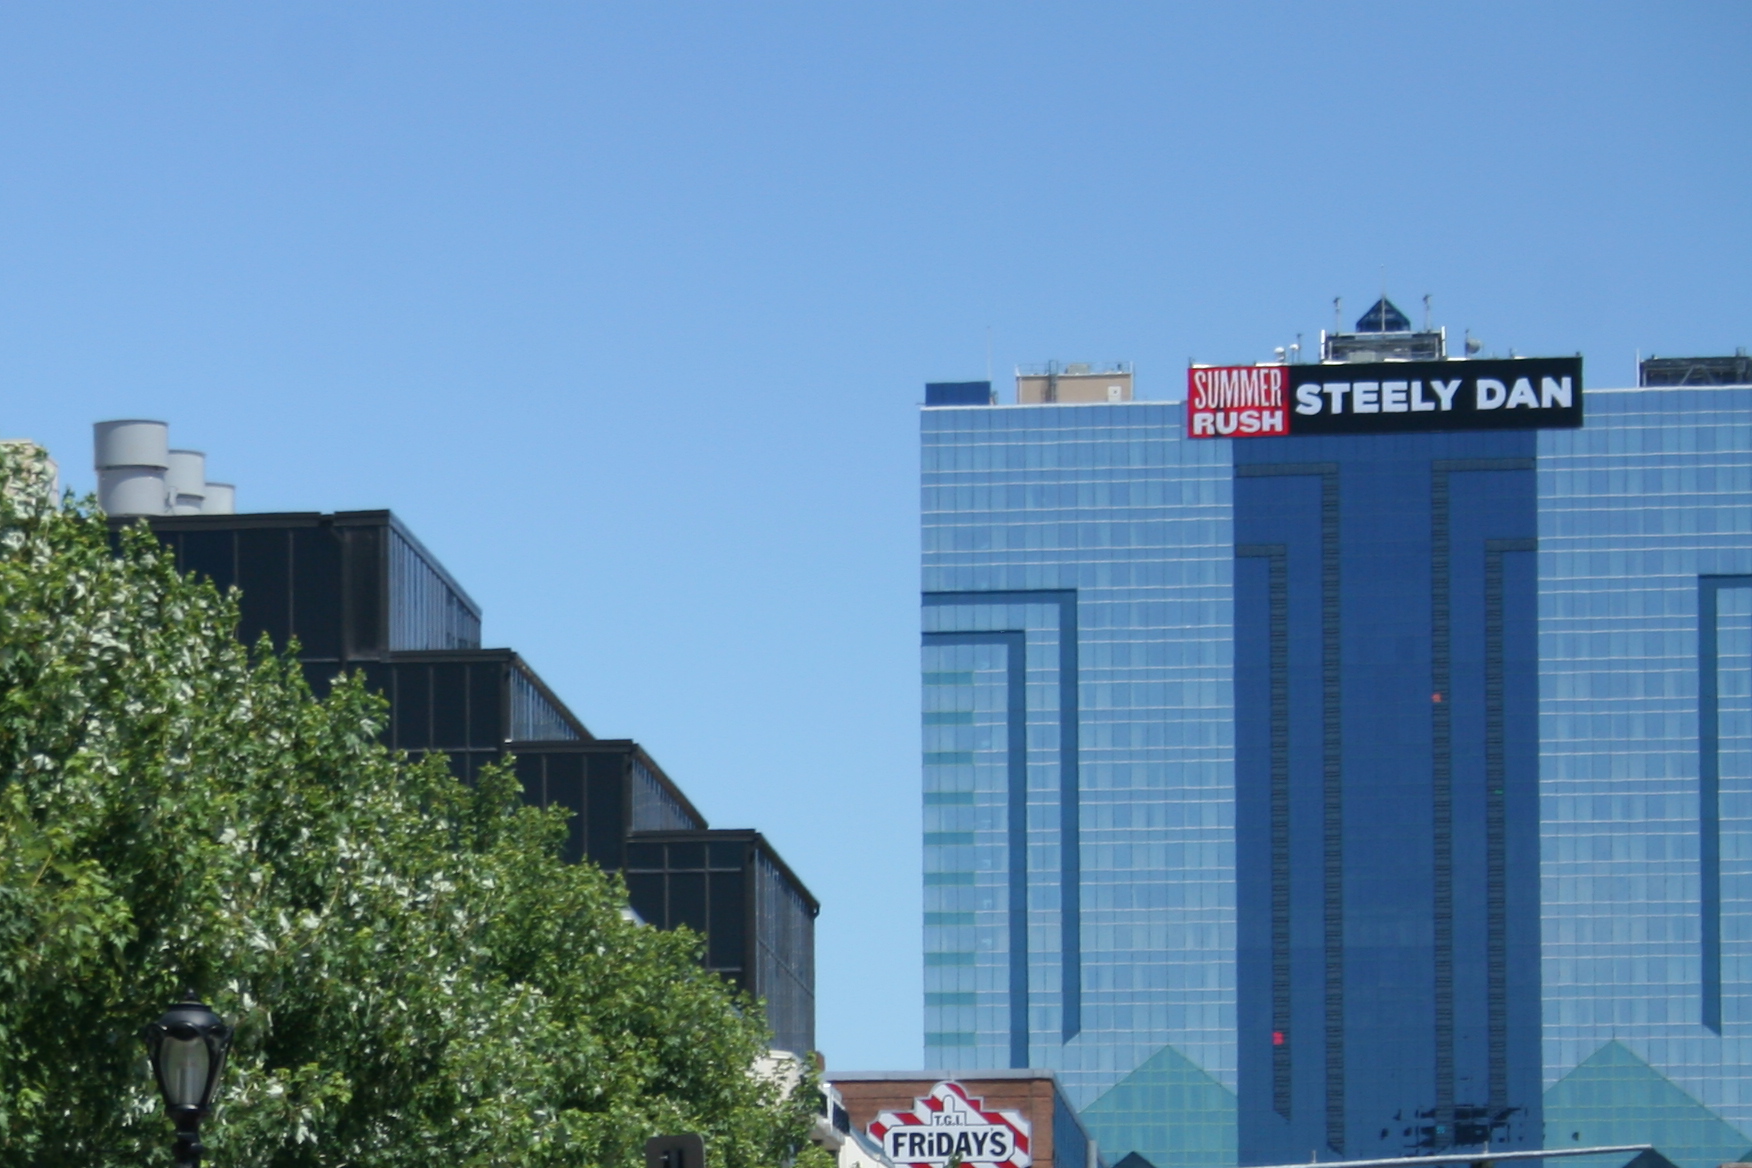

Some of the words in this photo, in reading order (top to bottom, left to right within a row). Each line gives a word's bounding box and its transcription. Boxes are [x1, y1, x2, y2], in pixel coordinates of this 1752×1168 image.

[1193, 367, 1283, 410] SUMMER
[1295, 379, 1463, 414] STEELY
[1476, 375, 1573, 410] DAN
[1193, 410, 1284, 436] RUSH
[933, 1115, 965, 1127] T.G.I.
